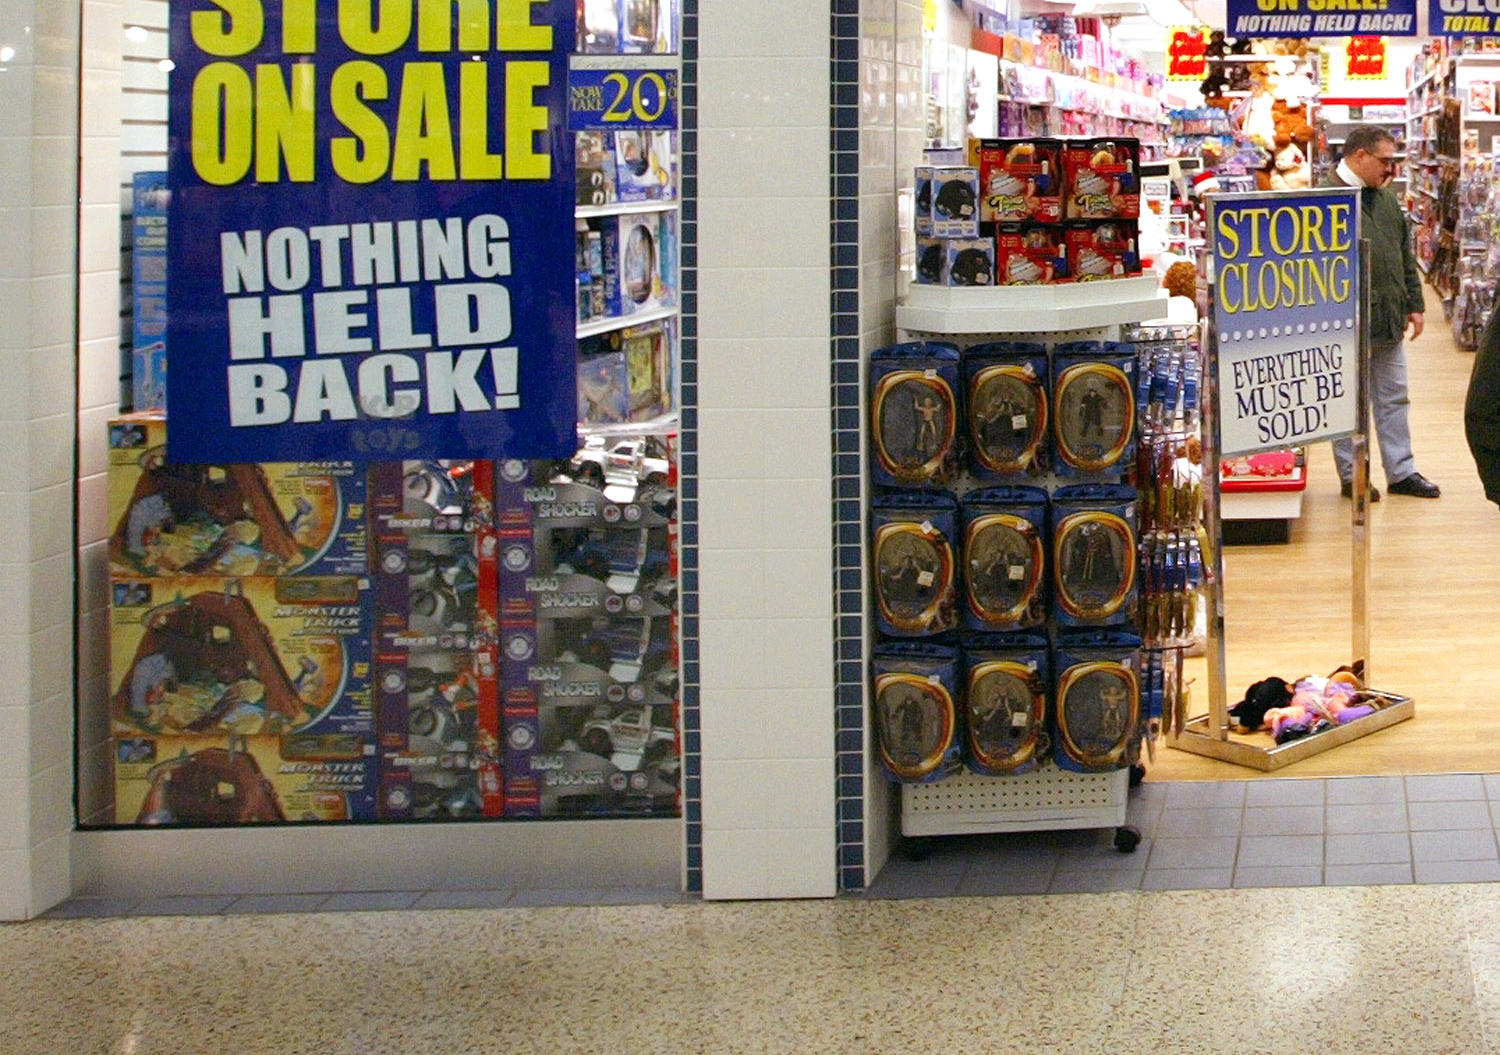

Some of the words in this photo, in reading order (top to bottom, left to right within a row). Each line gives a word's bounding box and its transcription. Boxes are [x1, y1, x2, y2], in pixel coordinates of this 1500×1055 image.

[1236, 14, 1306, 33] NOTHING
[1310, 14, 1348, 33] HELD
[1352, 14, 1411, 33] BACK!
[1443, 16, 1491, 33] TOTAL
[601, 71, 667, 122] 20
[191, 60, 314, 185] ON
[330, 60, 551, 183] SALE
[220, 214, 511, 293] NOTHING
[1217, 203, 1351, 259] STORE
[1219, 255, 1350, 314] CLOSING
[227, 283, 513, 358] HELD
[227, 347, 520, 427] BACK!
[1232, 343, 1343, 389] EVERYTHING
[1236, 379, 1308, 419] MUST
[1316, 372, 1345, 399] BE
[1257, 404, 1328, 443] SOLD!
[524, 487, 556, 502] ROAD
[539, 502, 597, 517] SHOCKER
[525, 577, 558, 591] ROAD
[273, 606, 361, 619] MONSTER
[279, 763, 364, 776] MONSTER
